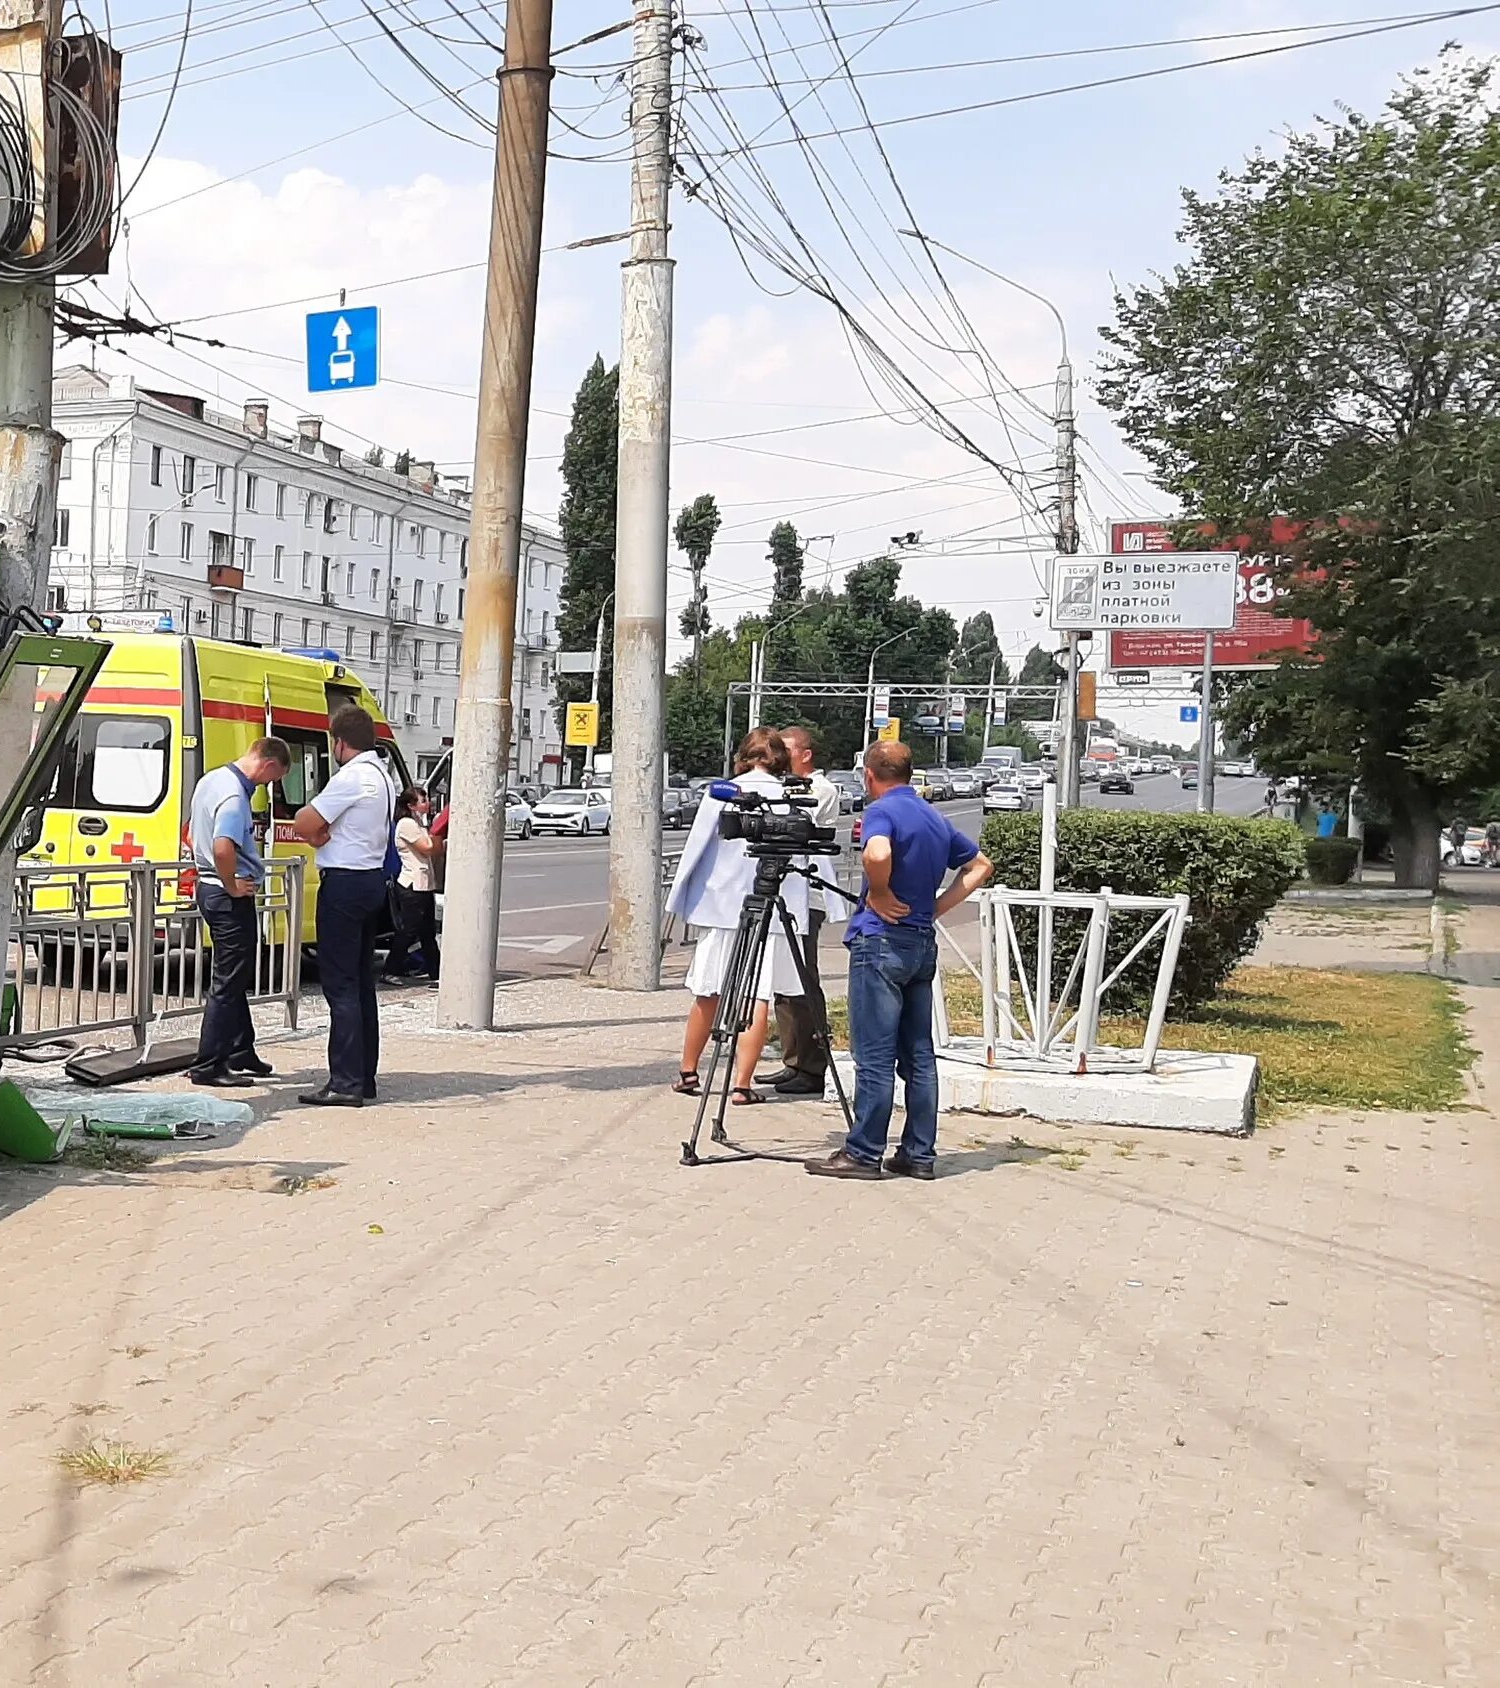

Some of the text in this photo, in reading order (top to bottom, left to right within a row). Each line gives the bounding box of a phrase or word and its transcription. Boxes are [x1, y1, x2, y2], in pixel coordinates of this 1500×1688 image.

[1103, 561, 1232, 574] Вы выезжаете
[1102, 580, 1176, 591] из зоны
[1101, 594, 1171, 608] платной
[1100, 613, 1182, 626] парковки
